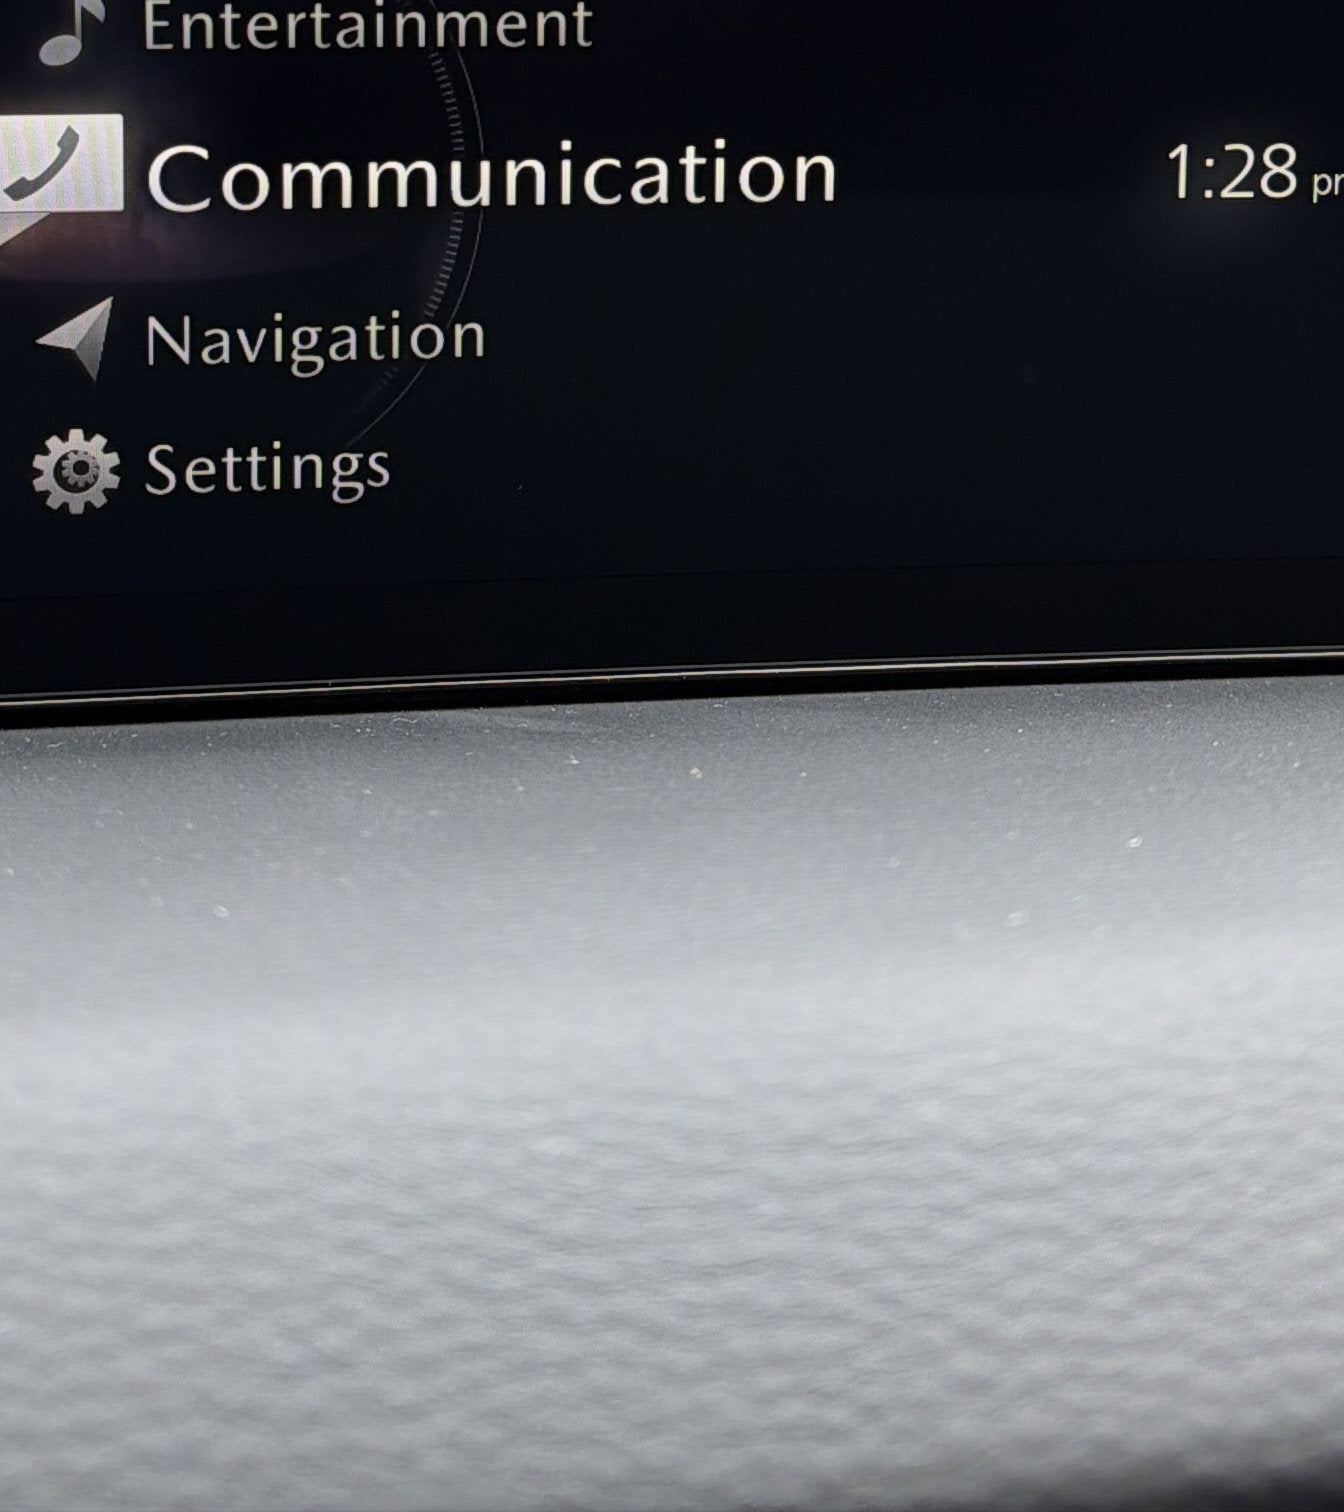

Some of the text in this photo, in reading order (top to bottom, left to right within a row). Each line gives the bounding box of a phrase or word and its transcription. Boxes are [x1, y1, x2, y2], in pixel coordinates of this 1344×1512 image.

[147, 138, 836, 214] Communication
[1167, 142, 1298, 200] 1:28
[146, 309, 485, 379] Navigation
[144, 439, 391, 505] Settings
